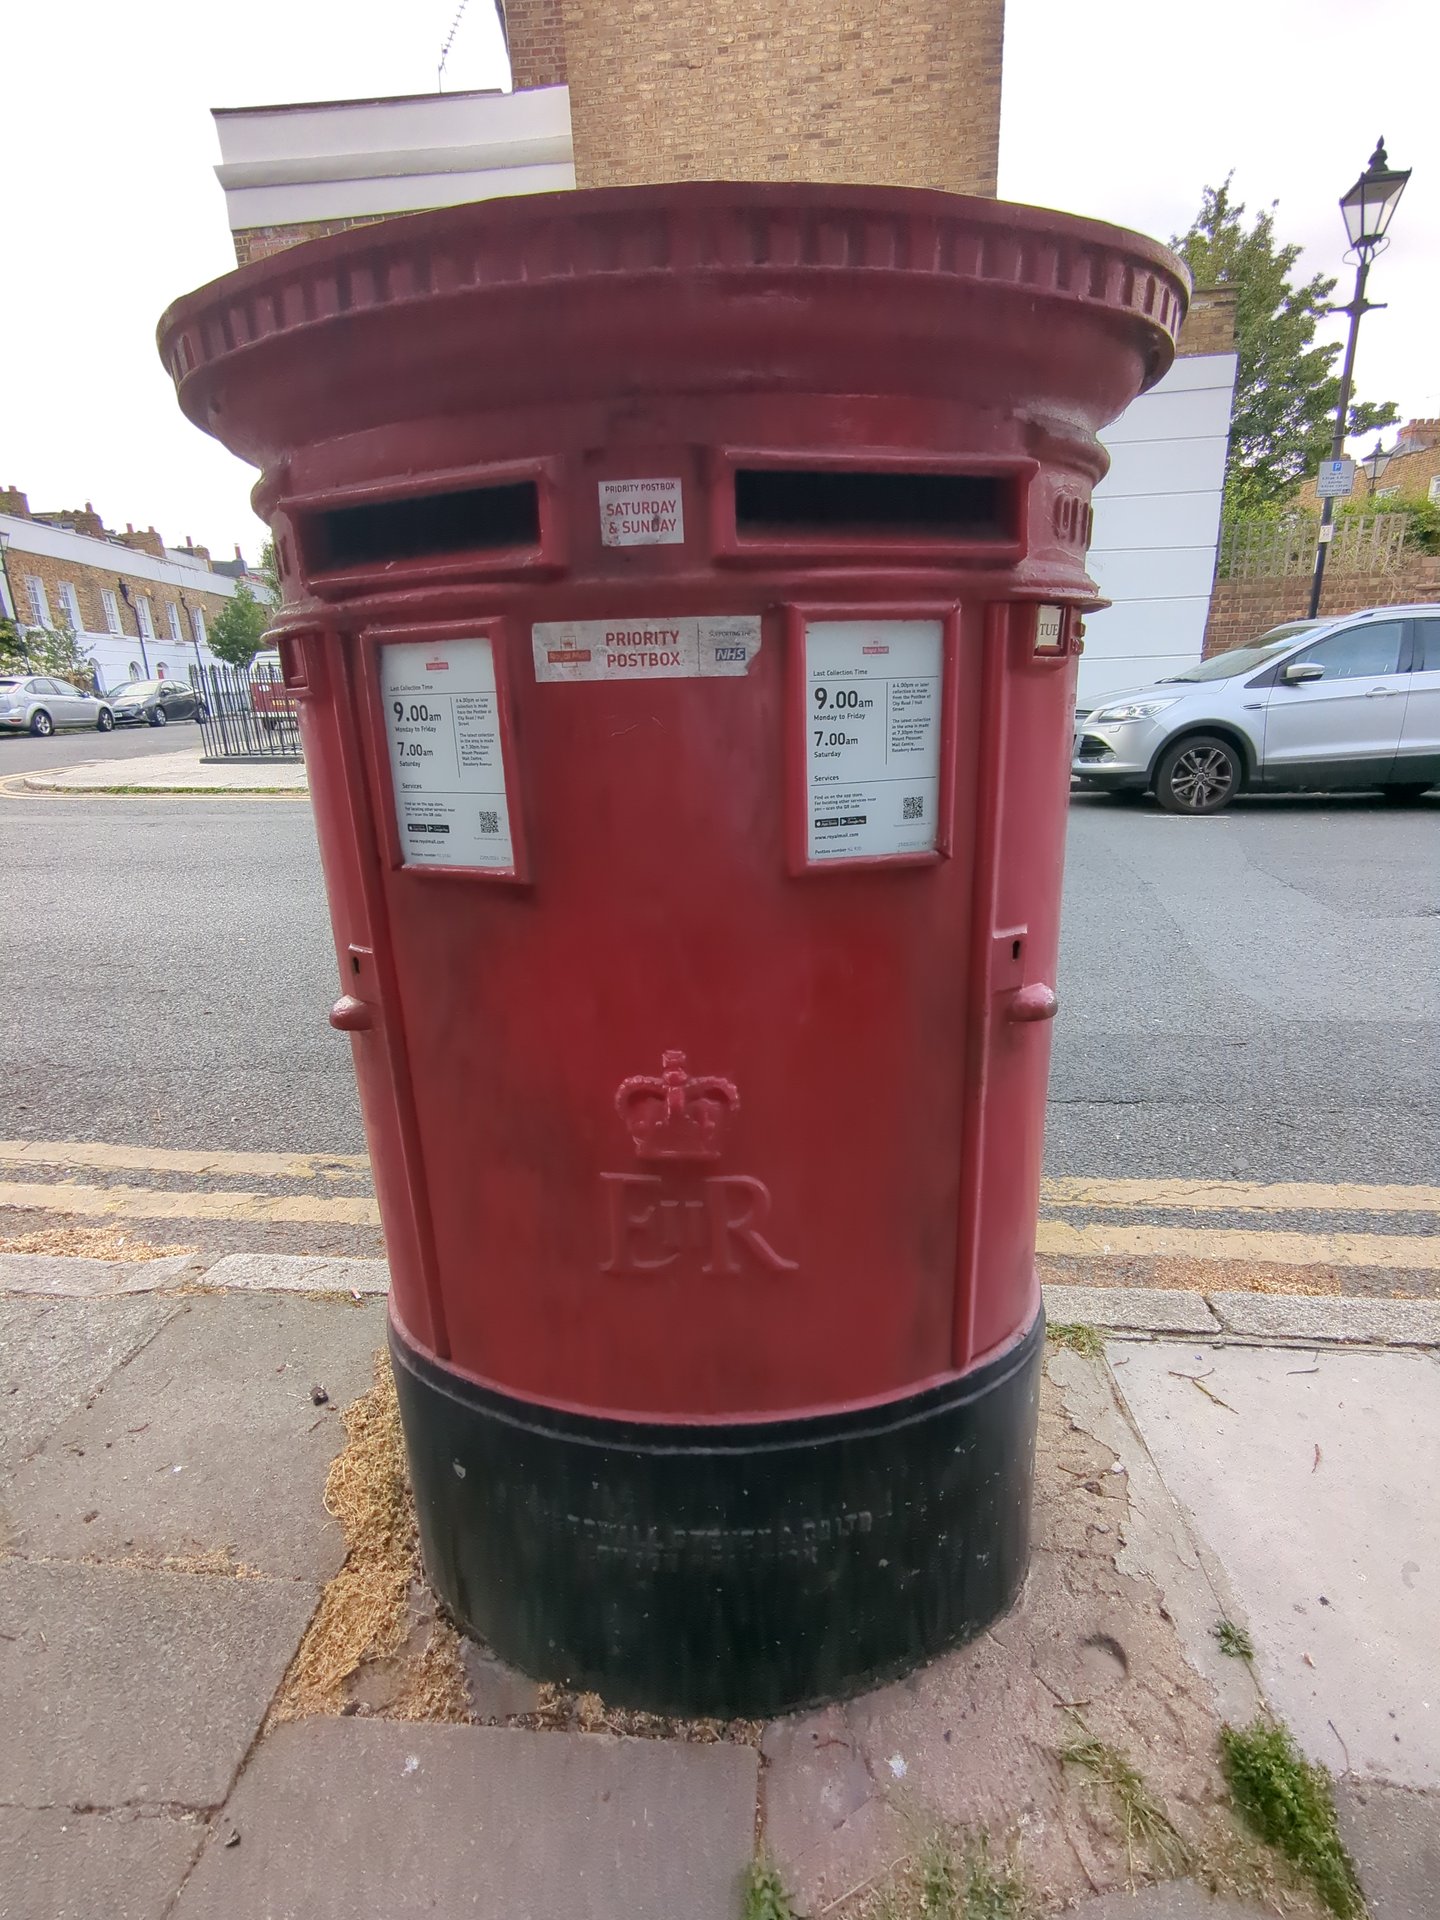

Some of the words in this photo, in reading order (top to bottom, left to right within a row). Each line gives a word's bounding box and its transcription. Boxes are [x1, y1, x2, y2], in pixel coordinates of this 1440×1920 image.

[605, 484, 638, 494] PRIORITY
[641, 482, 675, 491] POSTBOX
[606, 500, 676, 516] SATURDAY
[608, 521, 618, 534] &
[622, 519, 677, 534] SUNDAY
[1040, 624, 1058, 636] TUE
[605, 630, 680, 647] PRIORITY
[607, 652, 680, 668] POSTBOX
[717, 649, 744, 659] NHS
[814, 687, 873, 710] 9.00am
[393, 702, 442, 723] 9.00am
[814, 714, 837, 722] Monday
[847, 712, 865, 720] Friday
[395, 726, 414, 734] Monday
[421, 725, 436, 733] Friday
[814, 731, 858, 747] 7.00am
[397, 742, 433, 757] 7.00am
